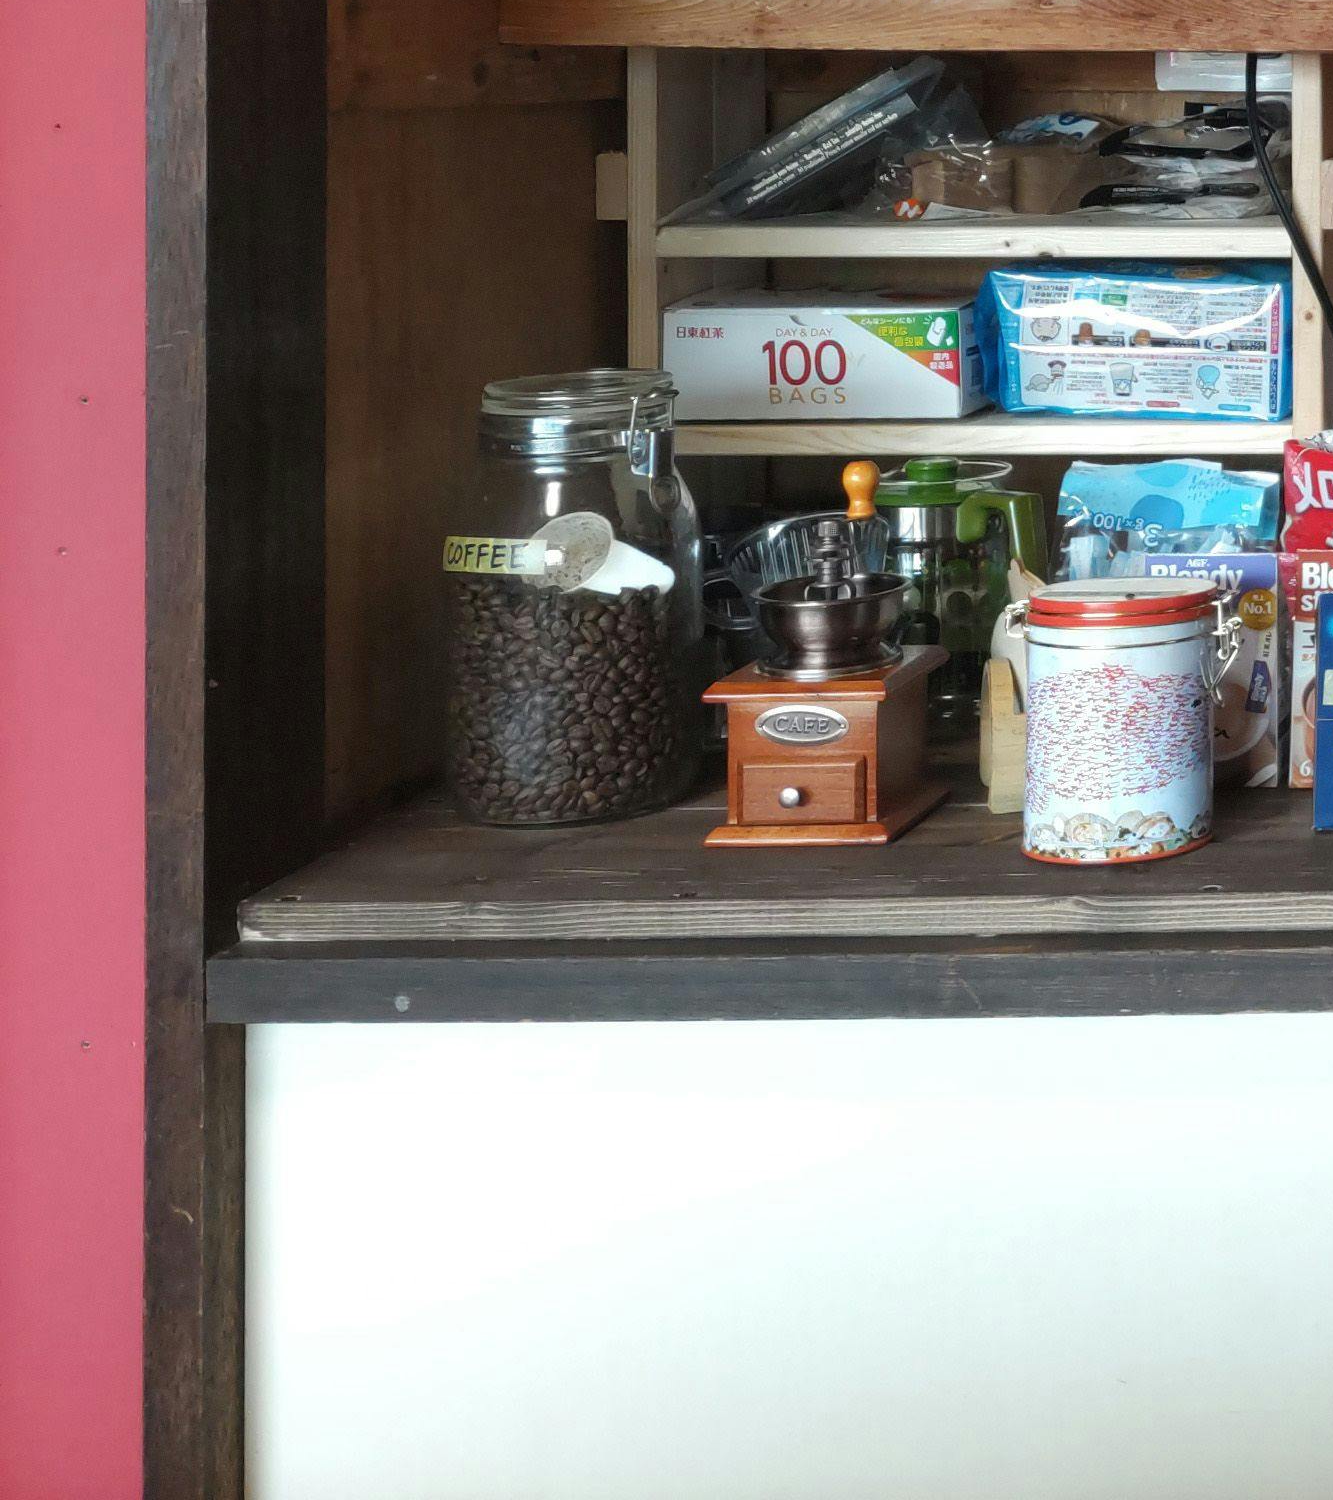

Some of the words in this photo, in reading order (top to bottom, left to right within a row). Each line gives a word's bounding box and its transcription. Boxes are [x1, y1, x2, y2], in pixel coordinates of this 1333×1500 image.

[676, 326, 724, 338] 日東紅茶
[775, 328, 798, 337] DAY
[801, 328, 808, 337] &
[810, 328, 832, 337] DAY
[879, 326, 907, 337] 便利な
[762, 339, 847, 386] 100
[768, 387, 846, 404] BAGS
[447, 542, 529, 569] COFFEE
[1243, 603, 1273, 615] No.1
[775, 716, 830, 734] CAFE
